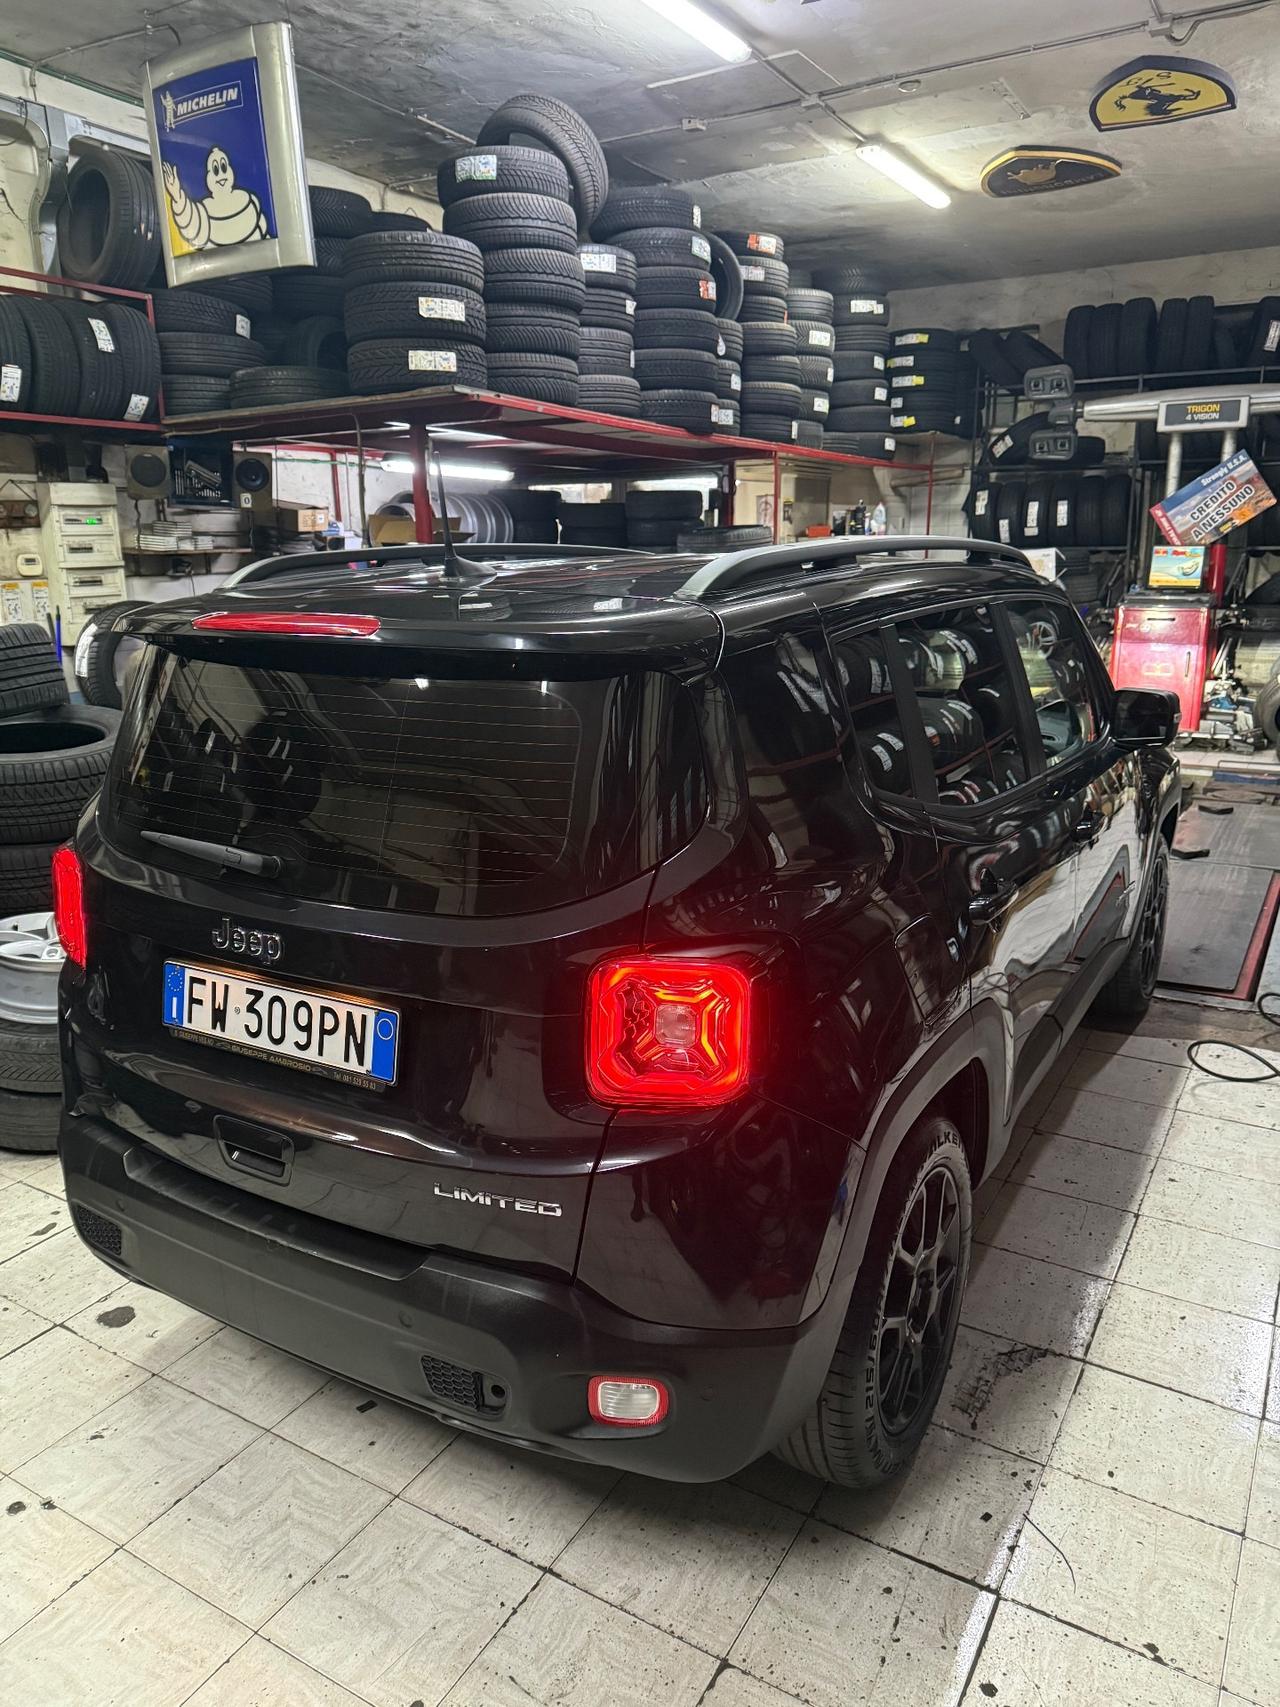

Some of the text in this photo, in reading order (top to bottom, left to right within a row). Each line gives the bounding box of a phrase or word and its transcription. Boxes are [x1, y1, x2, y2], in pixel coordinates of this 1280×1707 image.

[176, 87, 239, 116] MICHELIN
[1186, 403, 1220, 414] TRIGON
[1189, 480, 1236, 521] CREDITO
[1201, 484, 1254, 532] NESSUNO
[212, 918, 281, 965] Jeep
[187, 975, 368, 1067] FW 309PN
[268, 1056, 312, 1072] AMBROSIO
[434, 1182, 562, 1217] LIMITED
